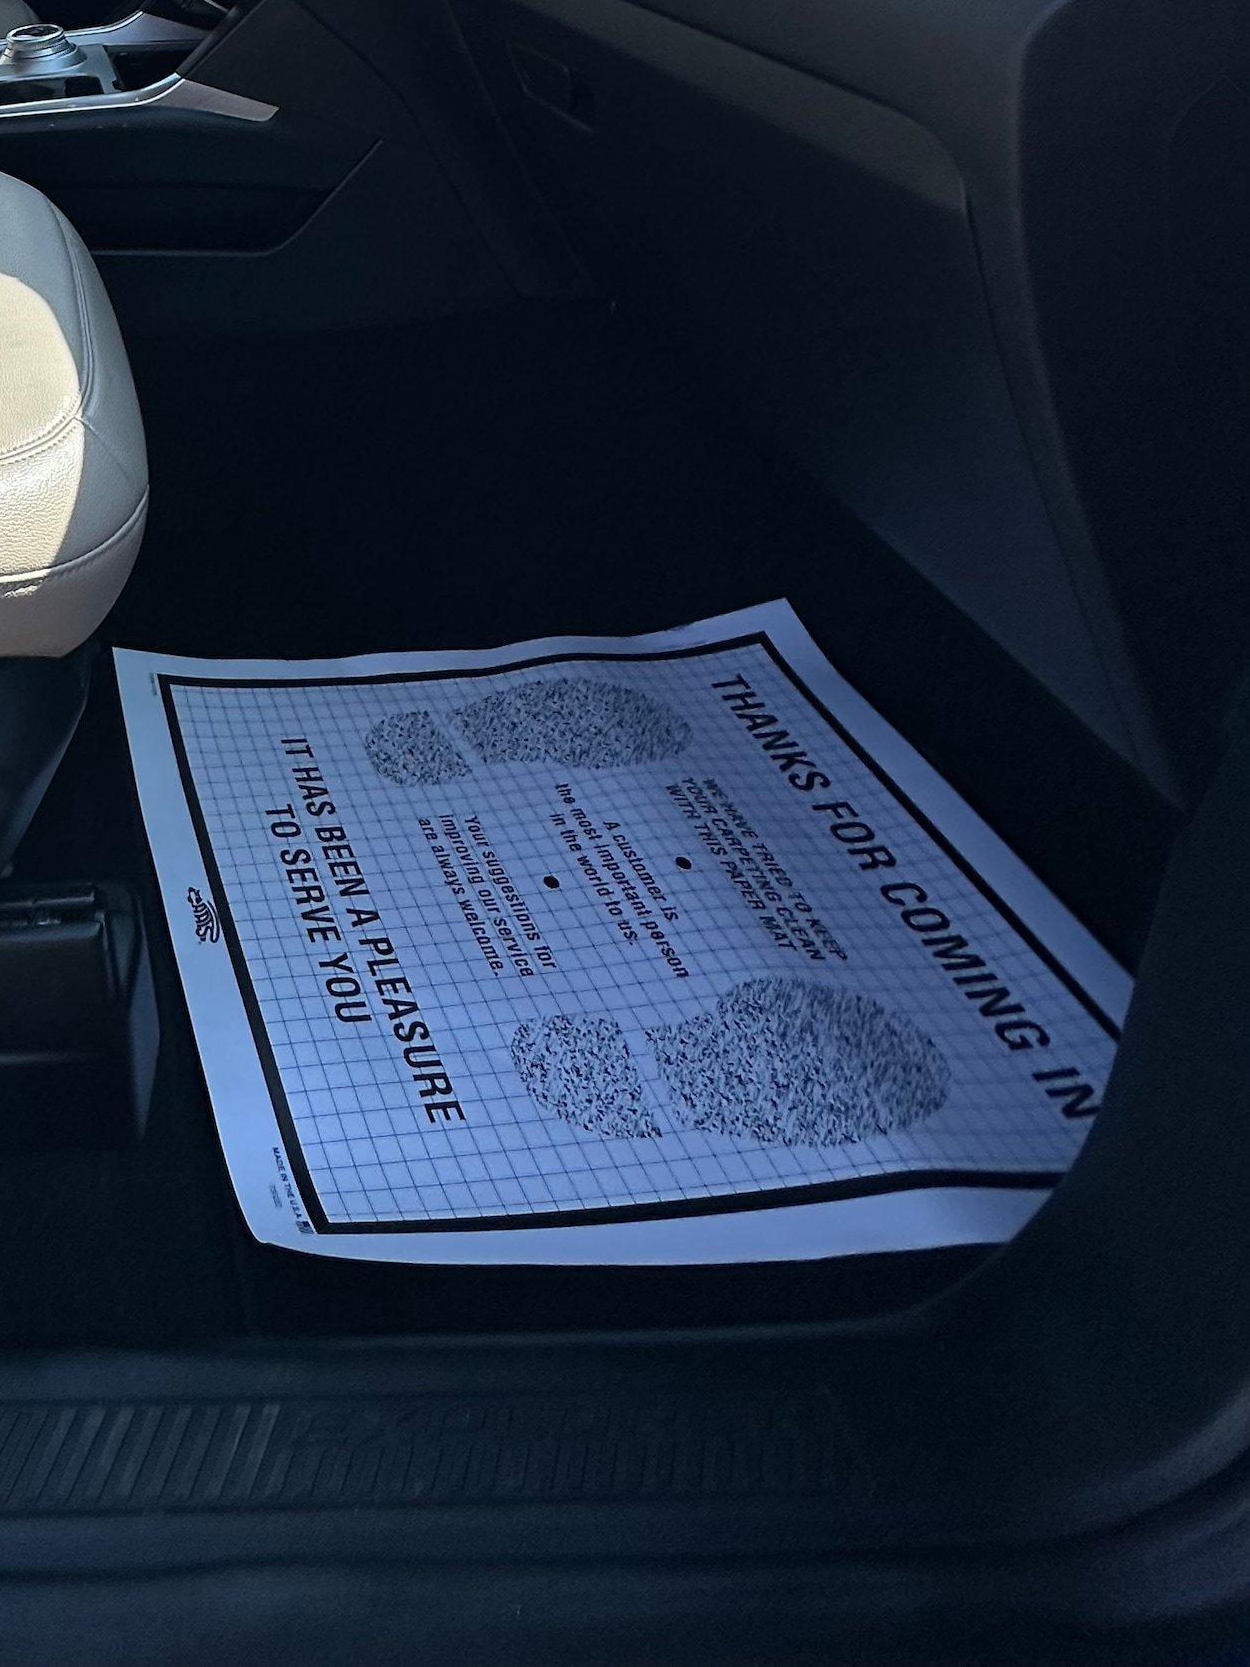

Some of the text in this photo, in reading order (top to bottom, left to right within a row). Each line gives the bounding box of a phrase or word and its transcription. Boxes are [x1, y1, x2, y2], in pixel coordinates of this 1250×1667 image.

[265, 803, 372, 1023] TO SERVE YOU
[281, 738, 466, 1123] IT HAS BEEN A PLEASURE
[418, 817, 504, 977] are always welcome.
[438, 814, 534, 977] improving our service
[464, 815, 557, 969] Your suggestions for
[549, 813, 638, 946] in the world to us.
[555, 783, 690, 979] the most important person
[603, 820, 679, 921] A customer is
[666, 783, 798, 952] WITH THIS PAPER MAT
[682, 776, 826, 962] YOUR CARPETING CLEAN
[711, 673, 1099, 1119] THANKS FOR COMING IN
[752, 841, 793, 888] TRIED
[788, 891, 813, 914] TO
[806, 914, 848, 961] KEEP
[272, 1147, 286, 1172] MADE
[280, 1173, 289, 1182] IN
[284, 1183, 295, 1198] THE
